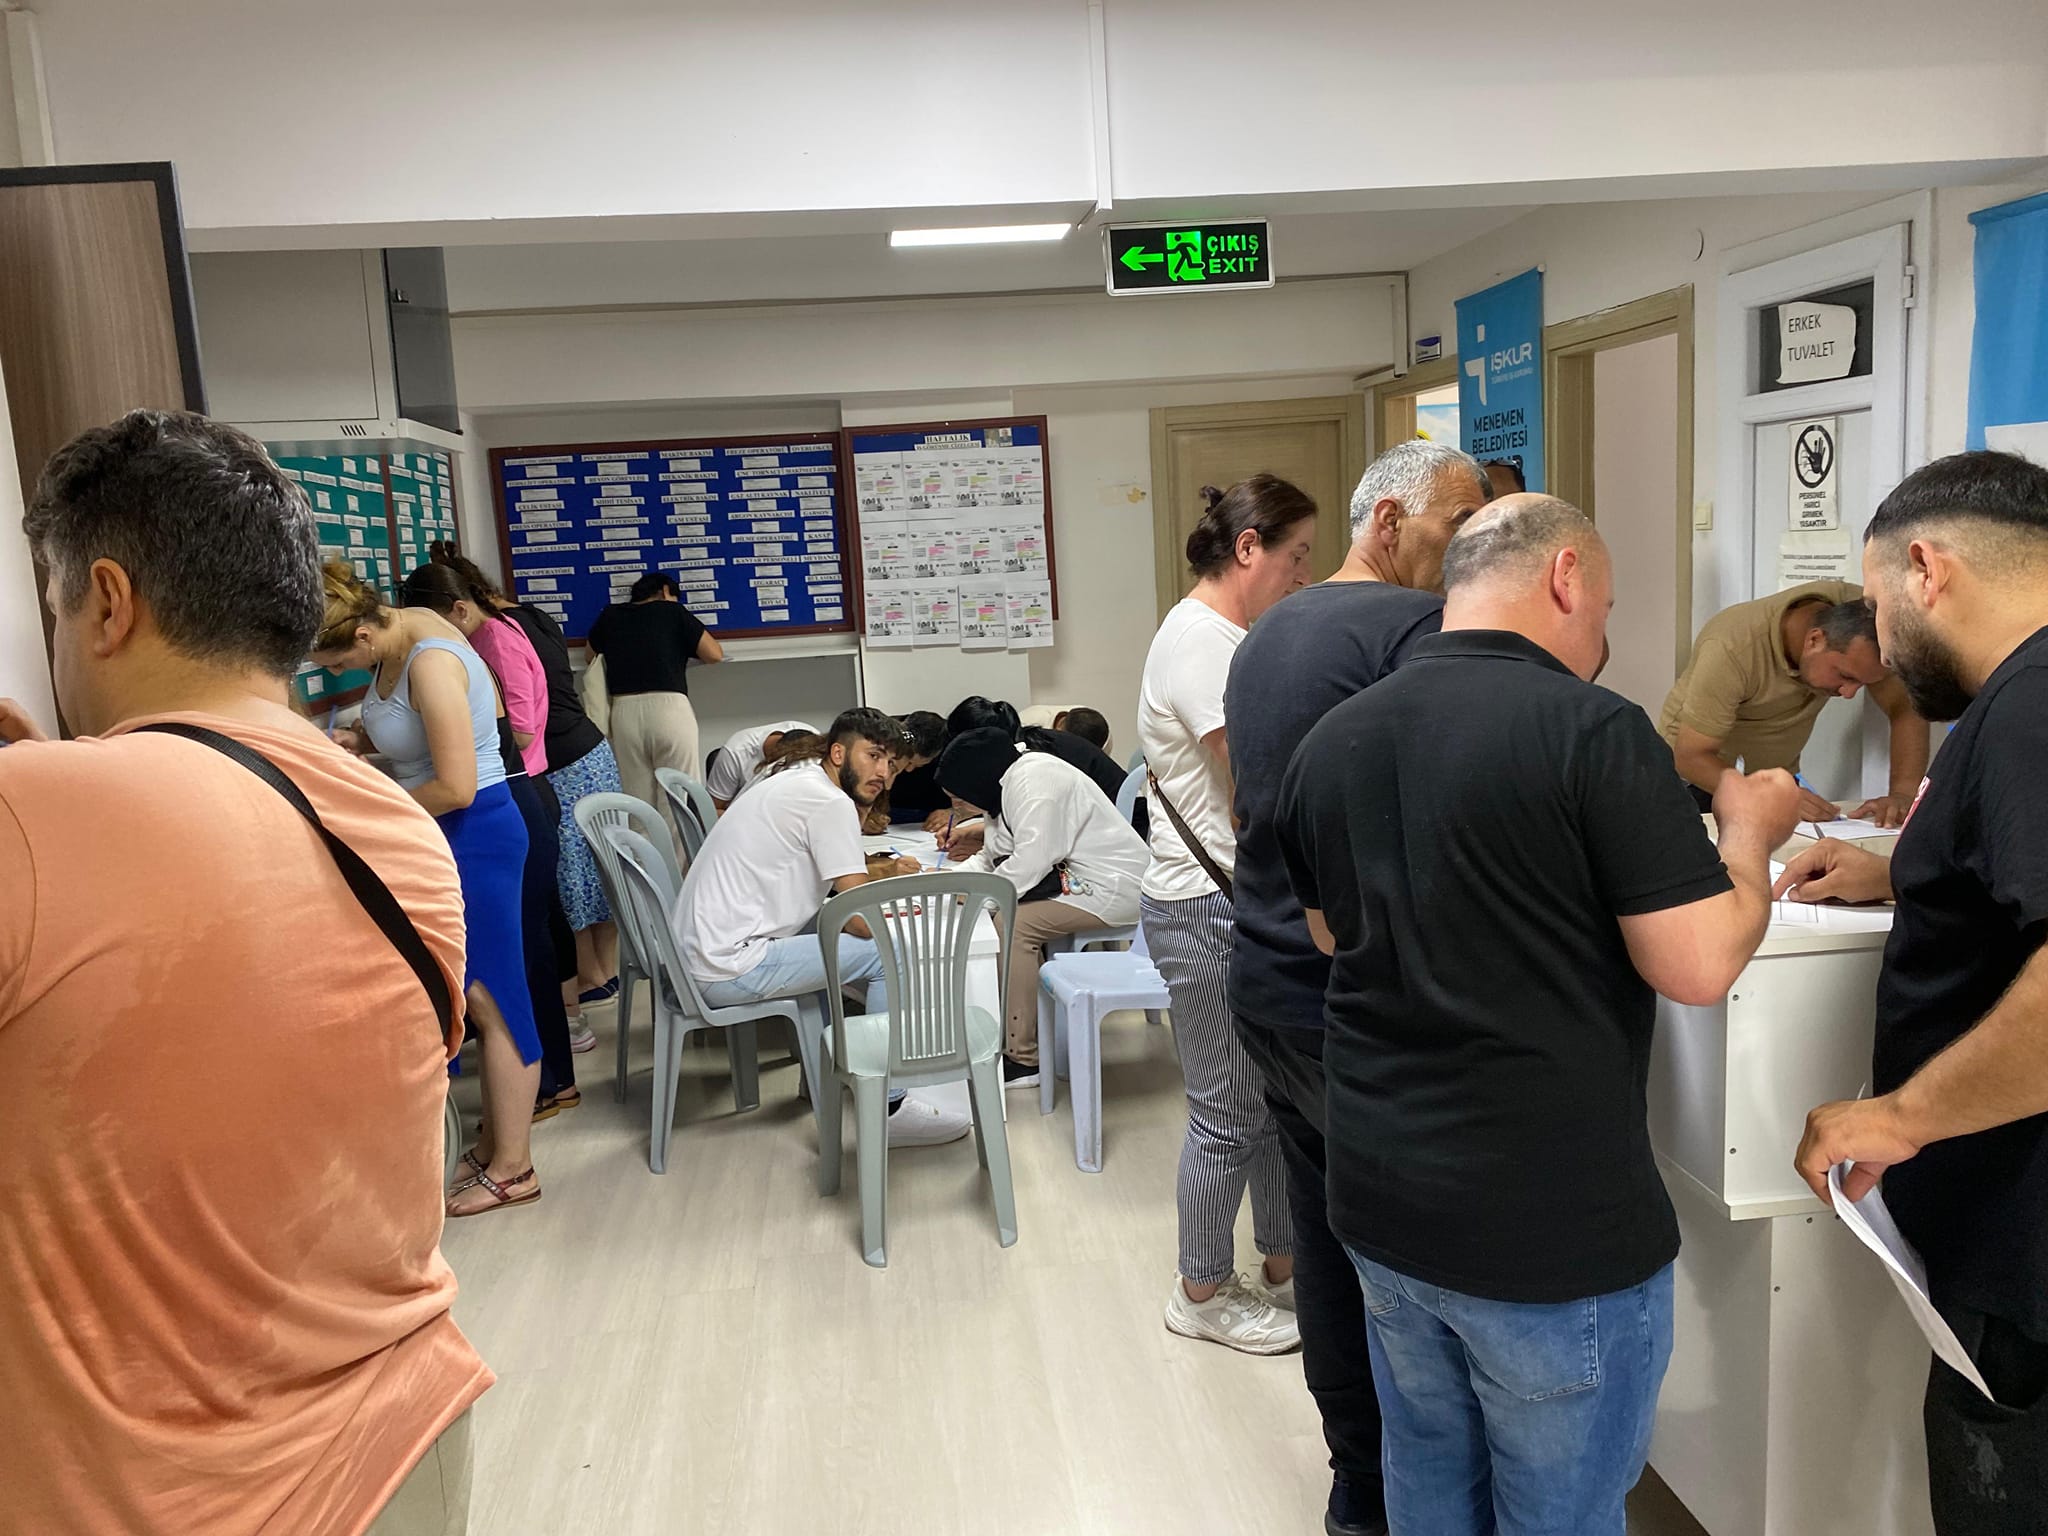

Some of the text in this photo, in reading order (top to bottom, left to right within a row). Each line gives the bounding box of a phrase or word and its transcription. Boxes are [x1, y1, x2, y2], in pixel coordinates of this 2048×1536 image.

[1206, 234, 1259, 257] ÇIKIŞ
[1209, 257, 1259, 273] EXIT
[1788, 313, 1821, 333] ERKEK
[1787, 341, 1835, 362] TUVALET
[1473, 408, 1524, 433] MENEMEN
[926, 434, 969, 443] HAFTALIK
[1472, 425, 1528, 455] BELEDİYESİ
[1799, 490, 1826, 500] PERSONEL
